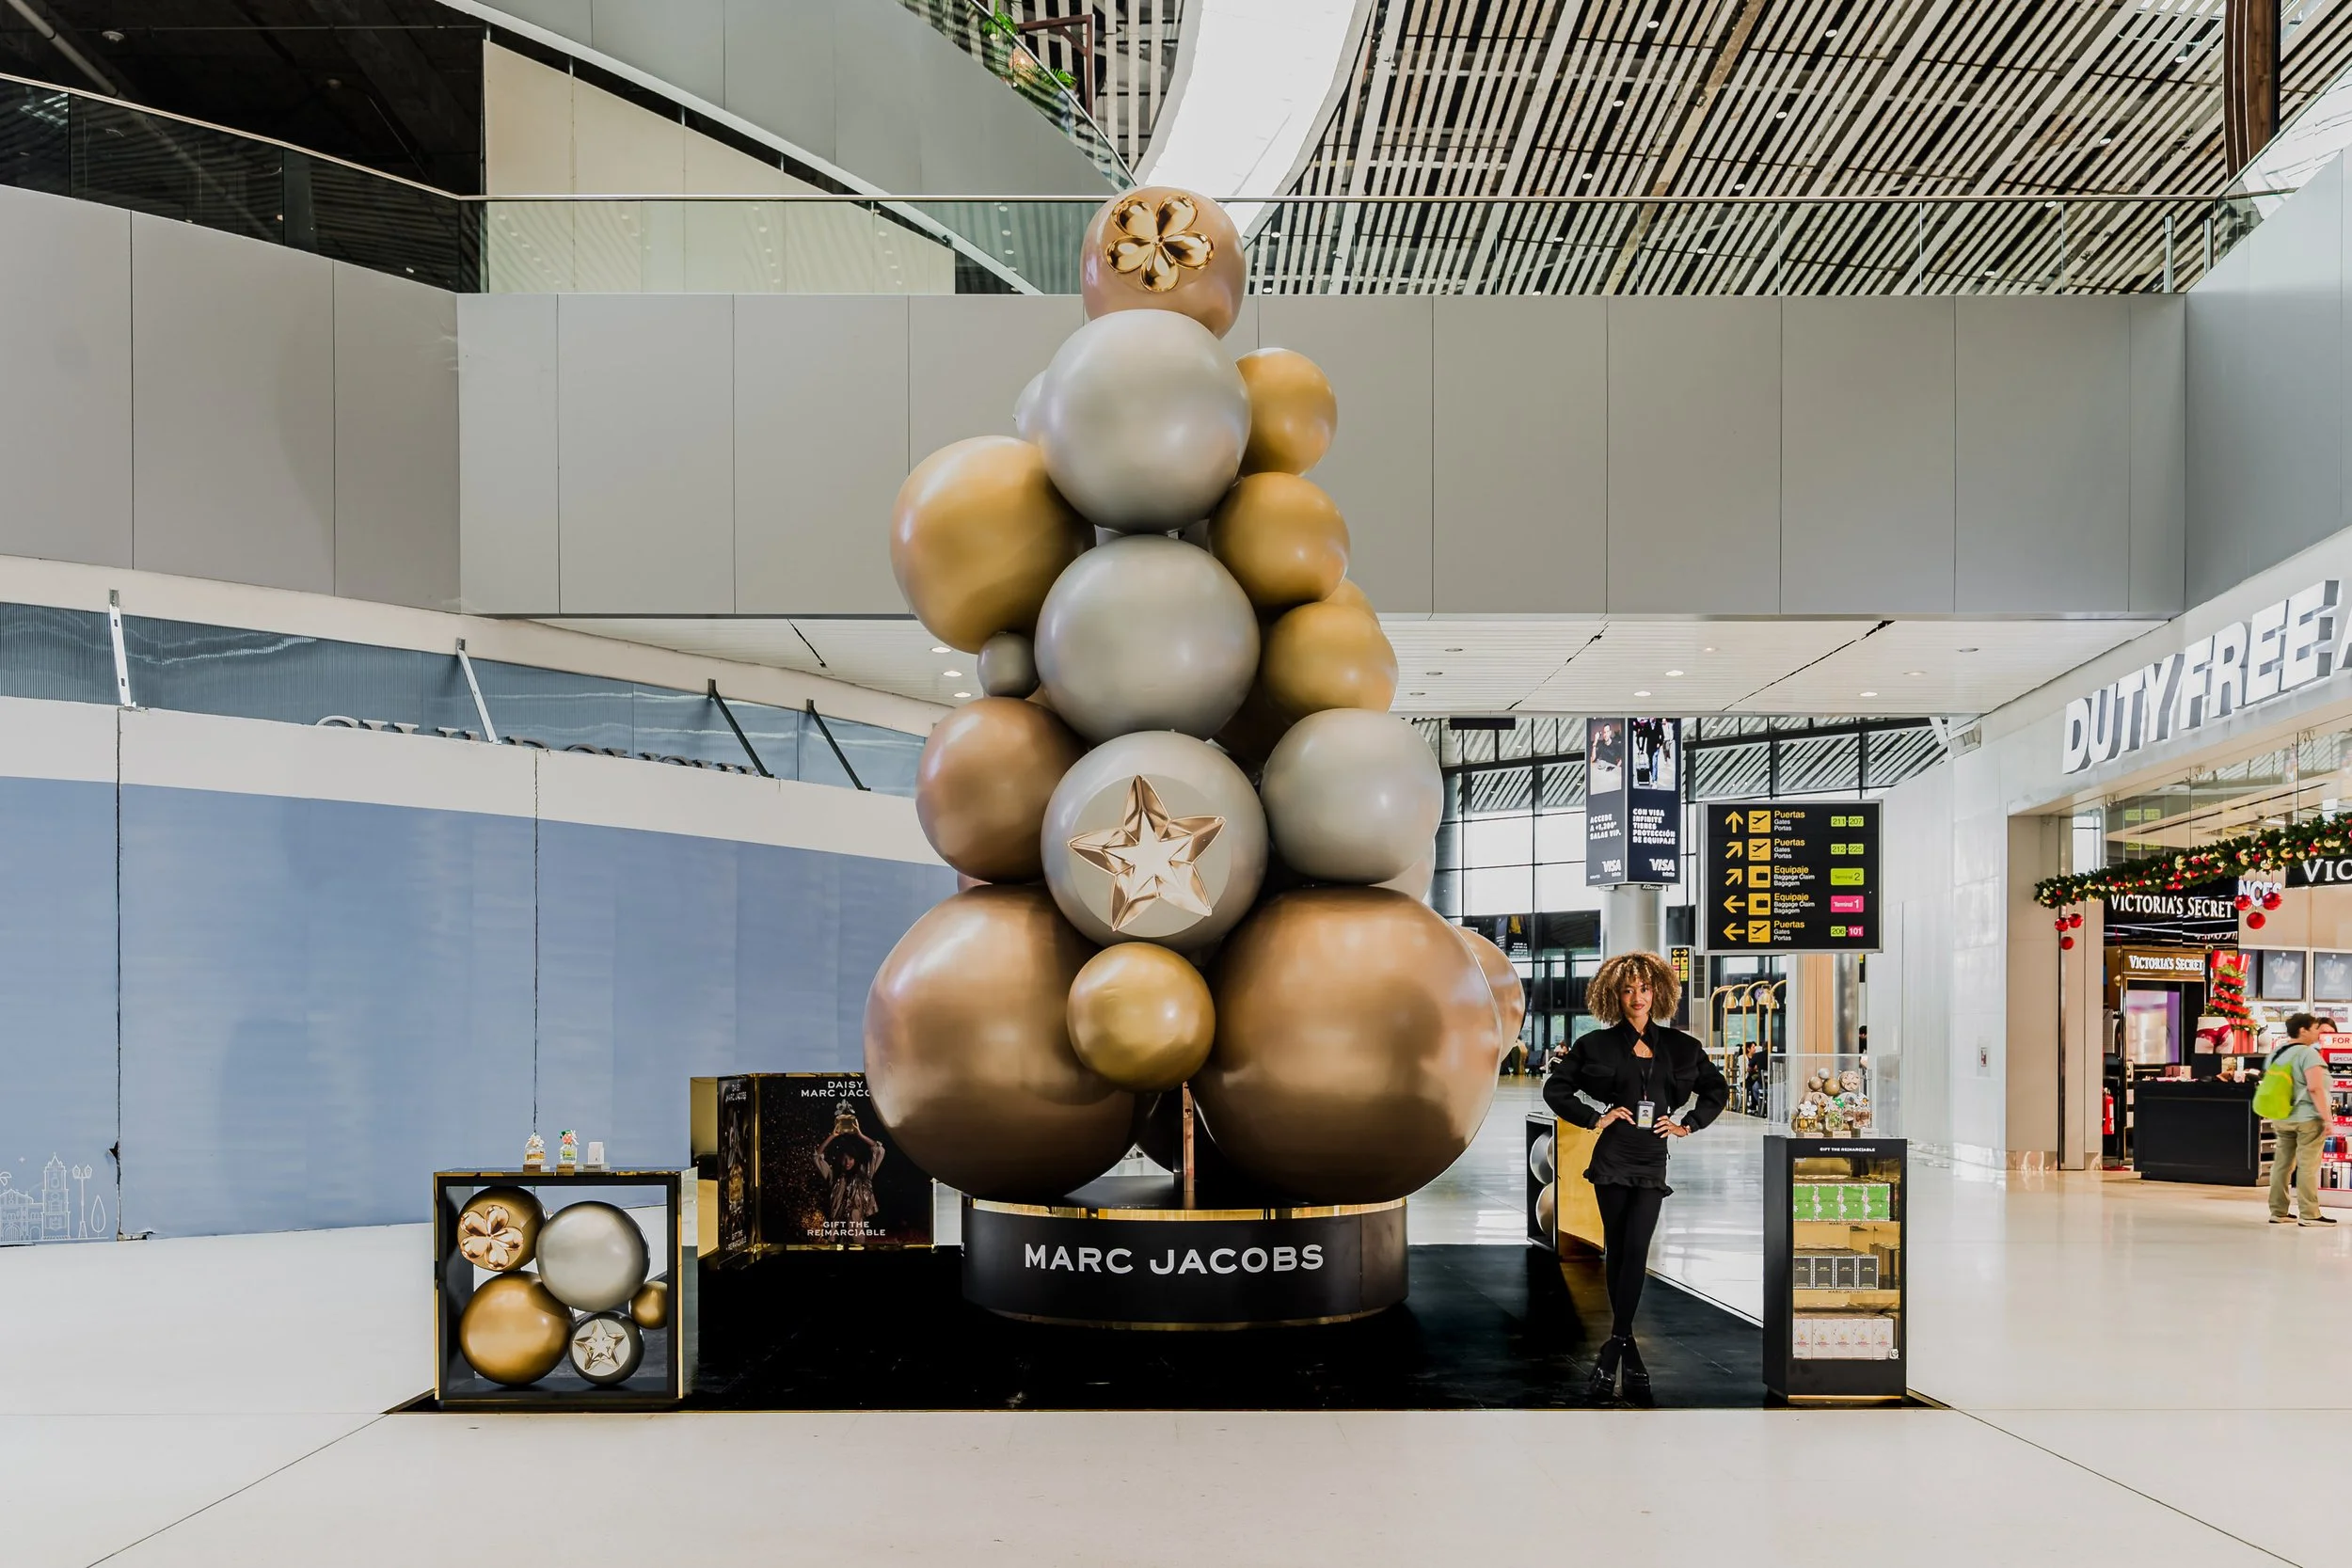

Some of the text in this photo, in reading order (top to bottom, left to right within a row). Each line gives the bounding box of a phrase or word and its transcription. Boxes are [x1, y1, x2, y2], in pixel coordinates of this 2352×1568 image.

[2063, 654, 2184, 774] DUTY
[2179, 580, 2340, 730] FREE
[1590, 814, 1613, 824] ACCEDE
[1774, 810, 1805, 818] Puertas
[1590, 829, 1621, 840] SALAS VIP.
[1632, 829, 1676, 837] PROTECCIÓN
[1644, 836, 1676, 845] EQUIPAJE
[1774, 838, 1805, 847] Puertas
[1601, 859, 1621, 872] VISA
[1649, 859, 1675, 871] VISA
[1774, 865, 1808, 877] Equipaje
[2302, 859, 2352, 882] VIC
[1774, 874, 1798, 882] Baggage
[1774, 893, 1808, 904] Equipaje
[1774, 901, 1798, 910] Baggage
[1854, 899, 1860, 909] 1
[2111, 894, 2233, 918] VICTORIA'S SECRET
[1774, 920, 1804, 928] Puertas
[2128, 955, 2203, 971] VICTORIA'S SECRET
[828, 1081, 864, 1089] DAISY
[801, 1089, 835, 1098] MARC
[806, 1228, 886, 1237] RE[MARC]ABLE
[1025, 1243, 1324, 1275] MARC JACOBS
